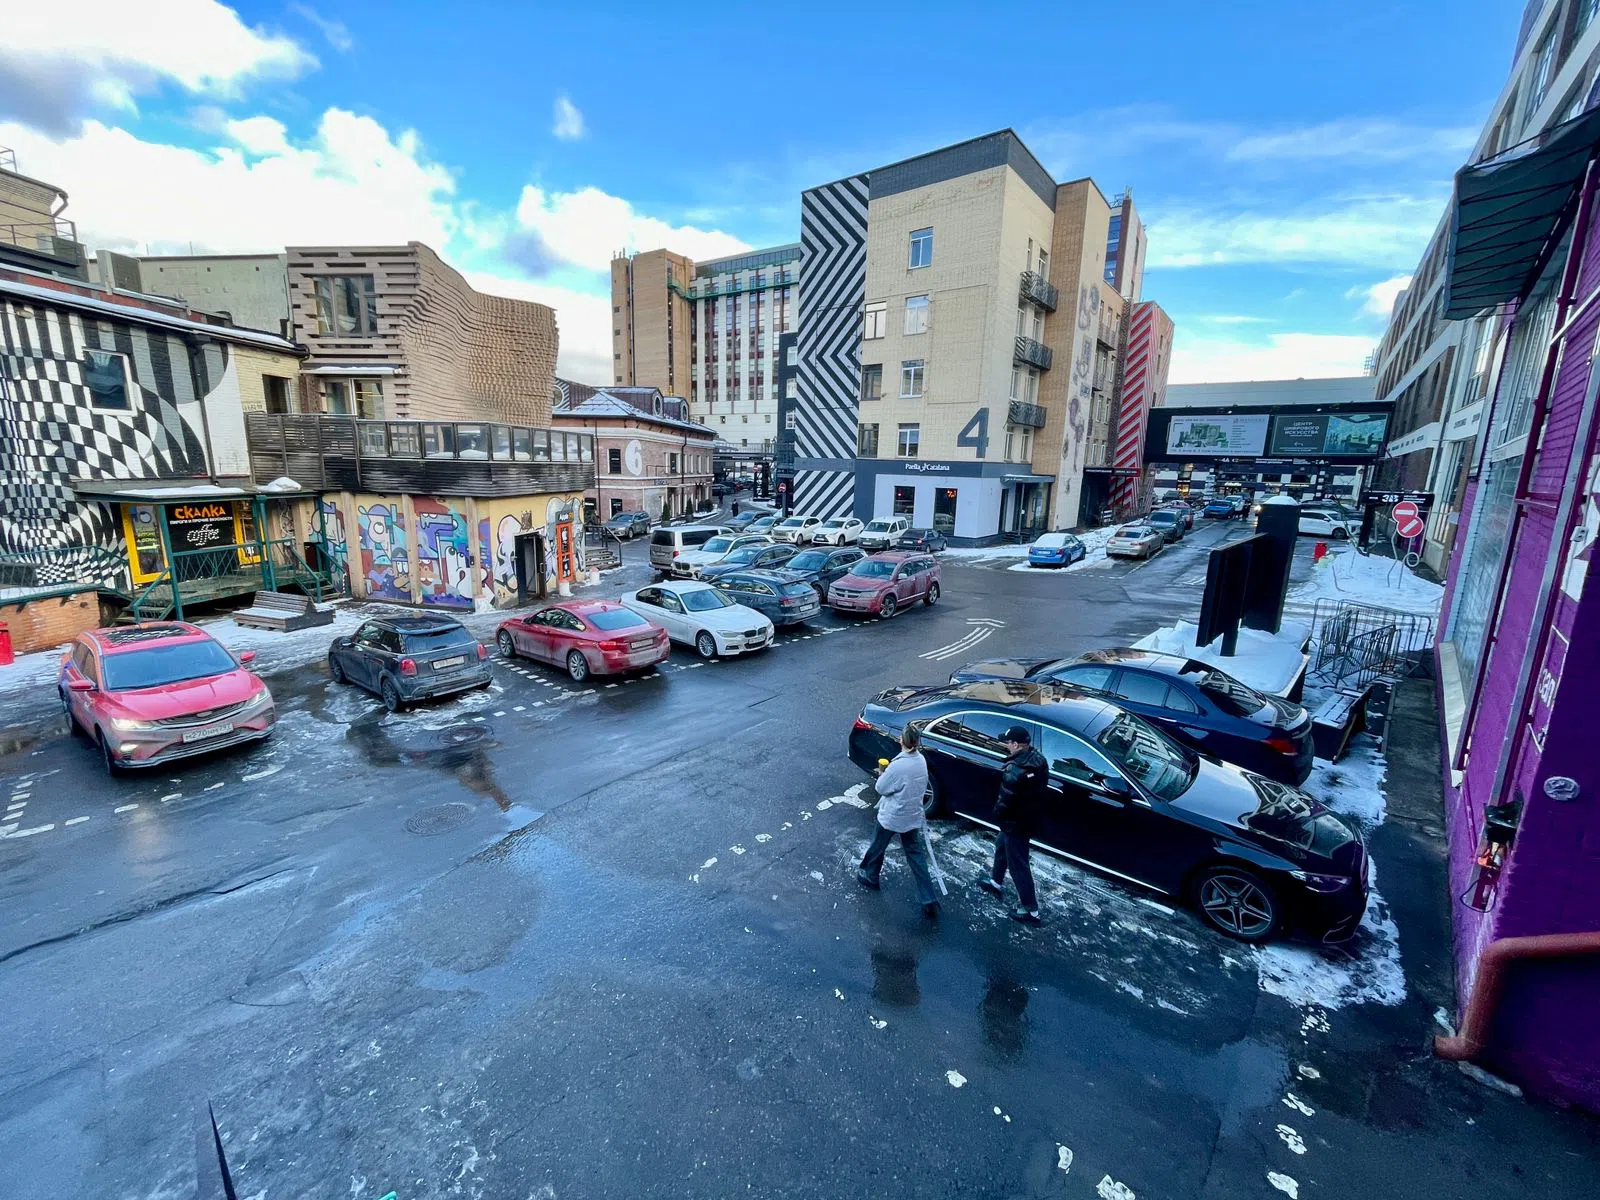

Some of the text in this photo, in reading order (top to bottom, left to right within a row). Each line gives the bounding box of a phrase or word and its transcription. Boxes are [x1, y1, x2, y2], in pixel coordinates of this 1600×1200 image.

[956, 407, 990, 459] 4
[625, 439, 643, 477] 6
[926, 463, 950, 471] Catalana
[174, 504, 226, 519] СКАЛКА
[186, 523, 220, 546] coffee
